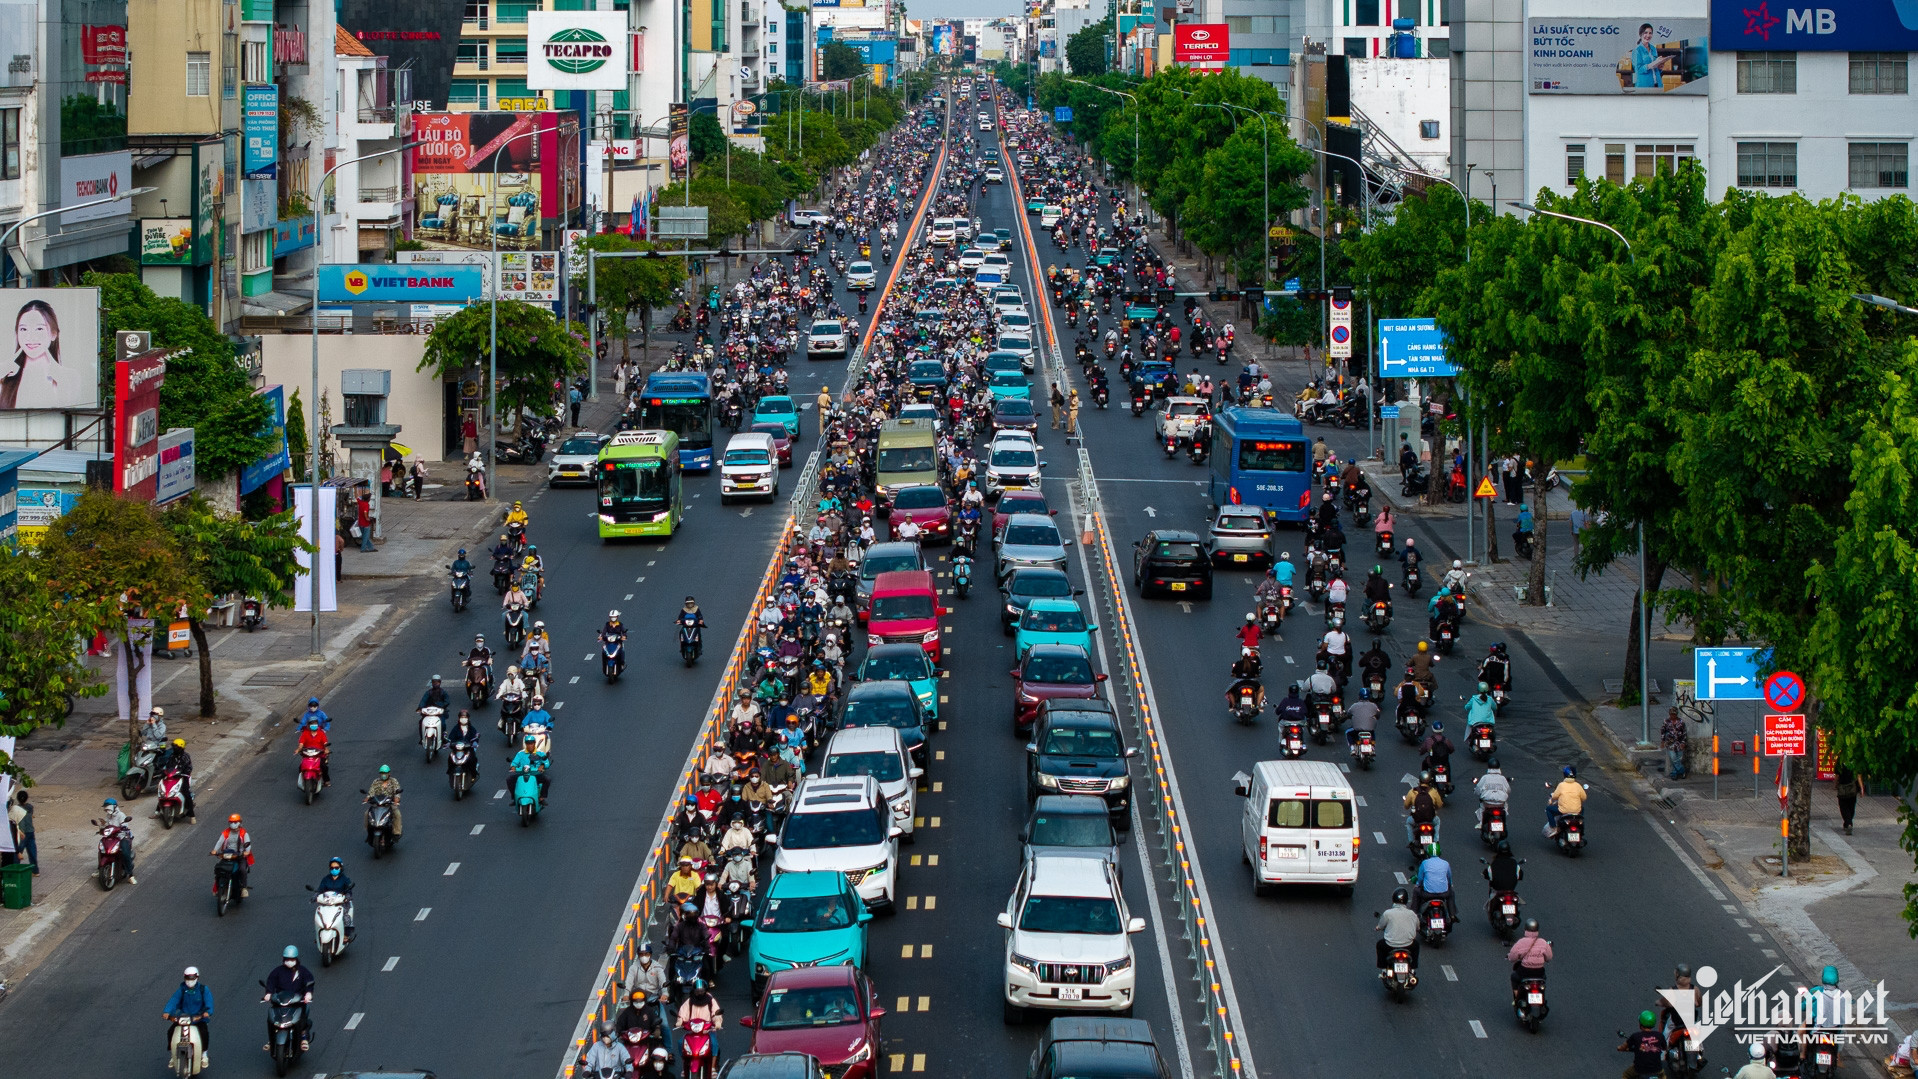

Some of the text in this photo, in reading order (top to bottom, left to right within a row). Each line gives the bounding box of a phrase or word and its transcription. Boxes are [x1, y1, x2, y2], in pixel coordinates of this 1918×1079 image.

[1786, 8, 1837, 34] MB
[365, 31, 441, 40] LOTTE CINEMA
[1533, 24, 1620, 37] LÃI SUẤT CỰC SỐC
[1533, 35, 1575, 46] BỨT TỐC
[543, 44, 612, 58] TECAPRO
[1533, 50, 1593, 58] KINH DOANH
[445, 126, 462, 142] BÒ
[76, 178, 108, 197] TECHCOMBANK
[348, 277, 455, 288] VB VIETBANK
